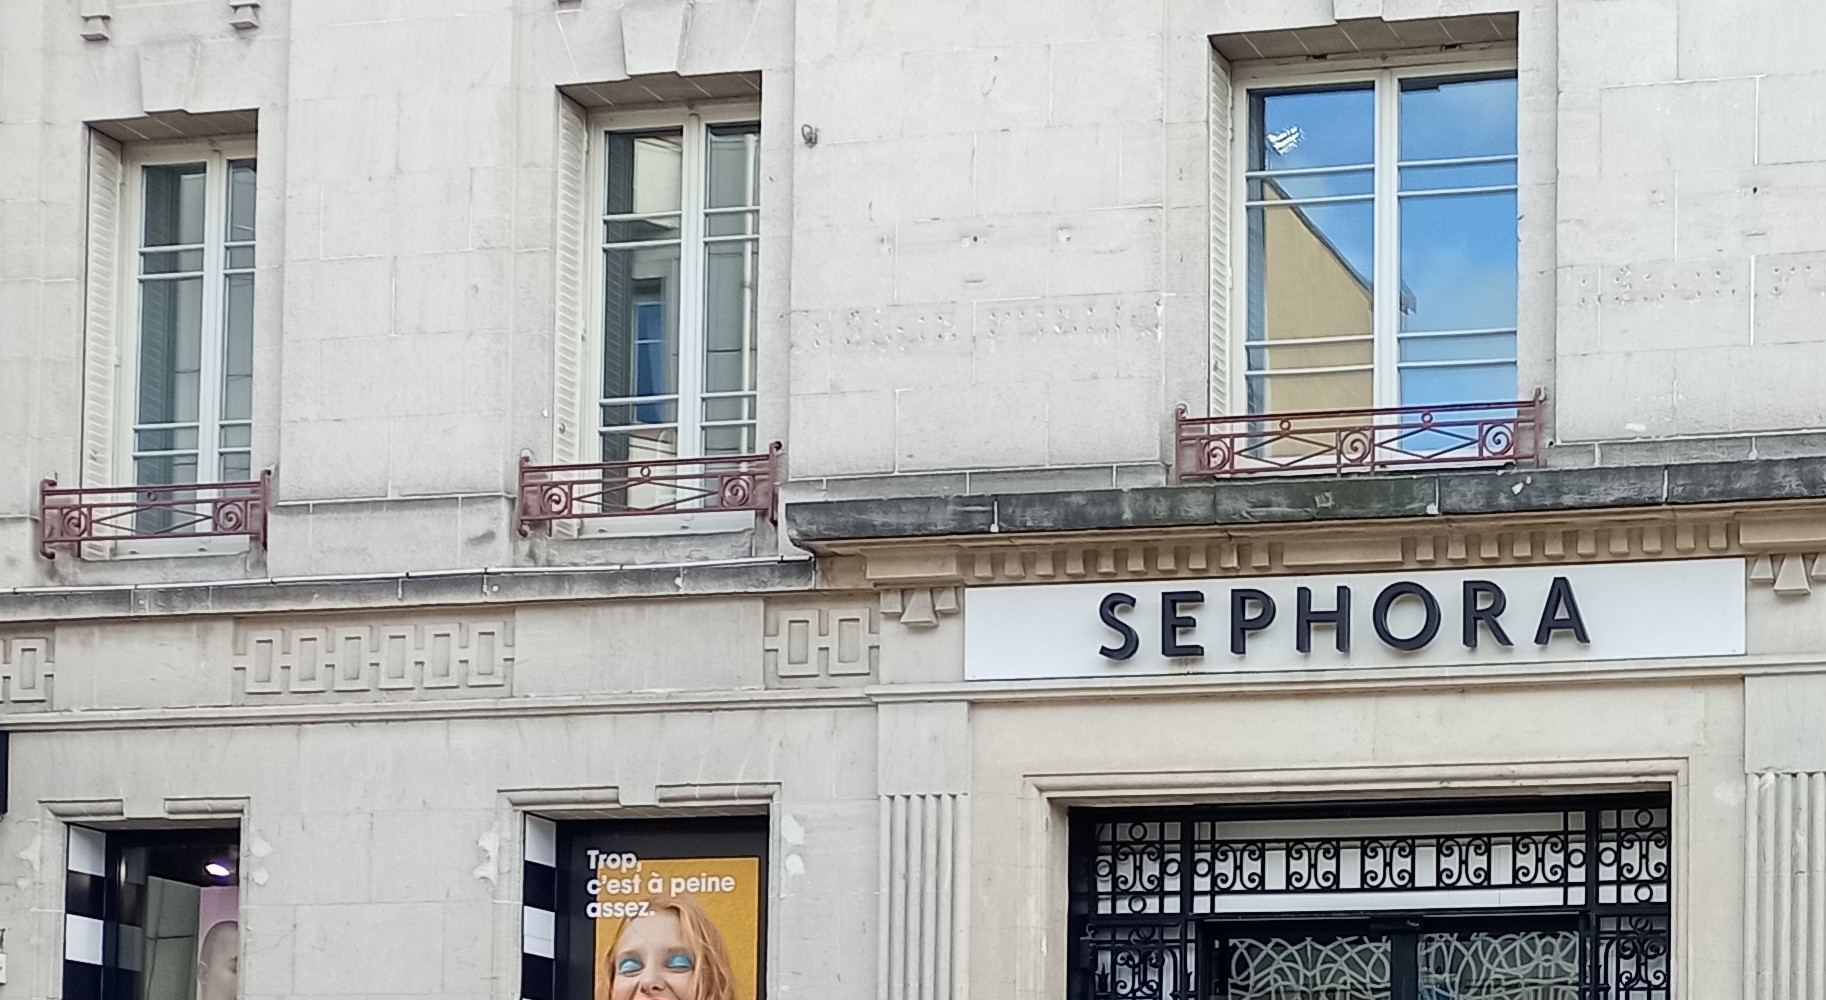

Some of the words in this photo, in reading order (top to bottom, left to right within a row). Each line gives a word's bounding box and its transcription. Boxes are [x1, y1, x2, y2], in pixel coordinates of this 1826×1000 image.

[1099, 576, 1591, 660] SEPHORA
[587, 850, 642, 873] Trop,
[587, 874, 641, 895] c'est
[647, 872, 664, 893] à
[670, 873, 735, 897] peine
[586, 901, 655, 917] assez.
